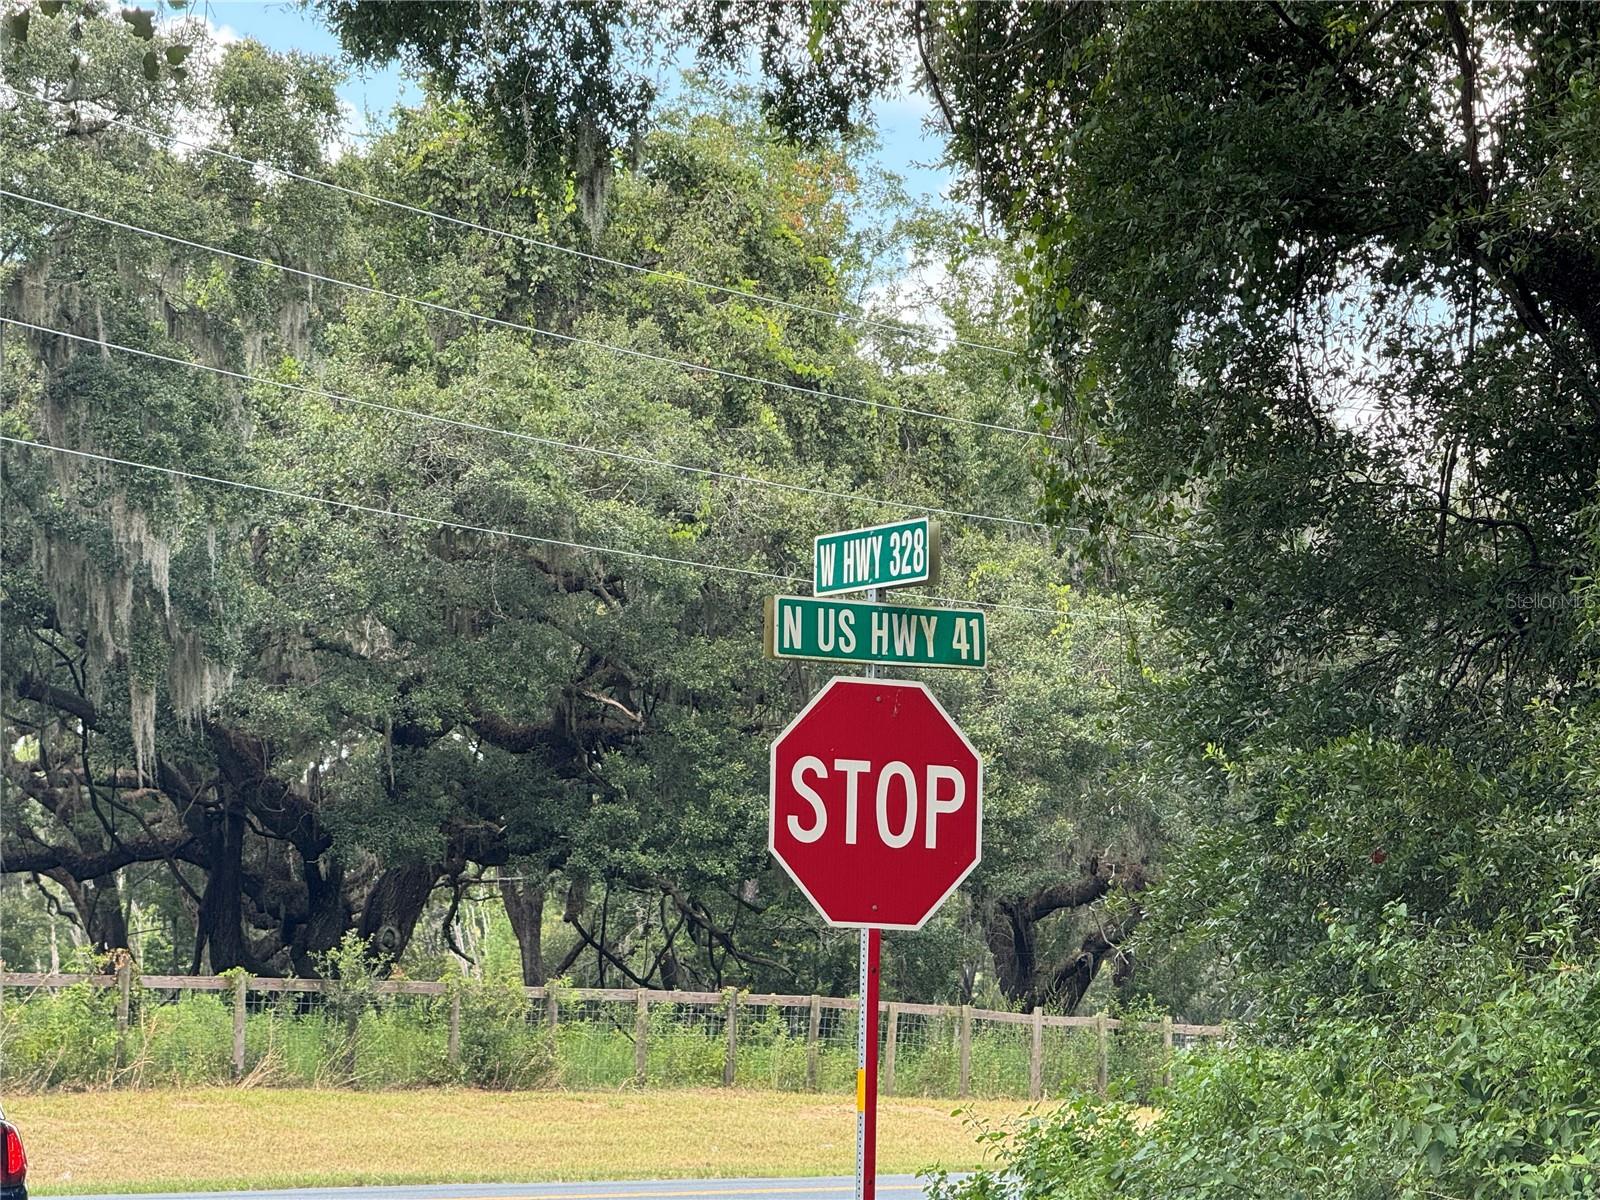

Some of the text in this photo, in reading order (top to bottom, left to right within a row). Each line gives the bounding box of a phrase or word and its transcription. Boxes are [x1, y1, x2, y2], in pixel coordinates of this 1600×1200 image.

[820, 527, 923, 587] W HWY 328
[783, 605, 980, 661] N US HWY 41
[787, 755, 966, 849] STOP
